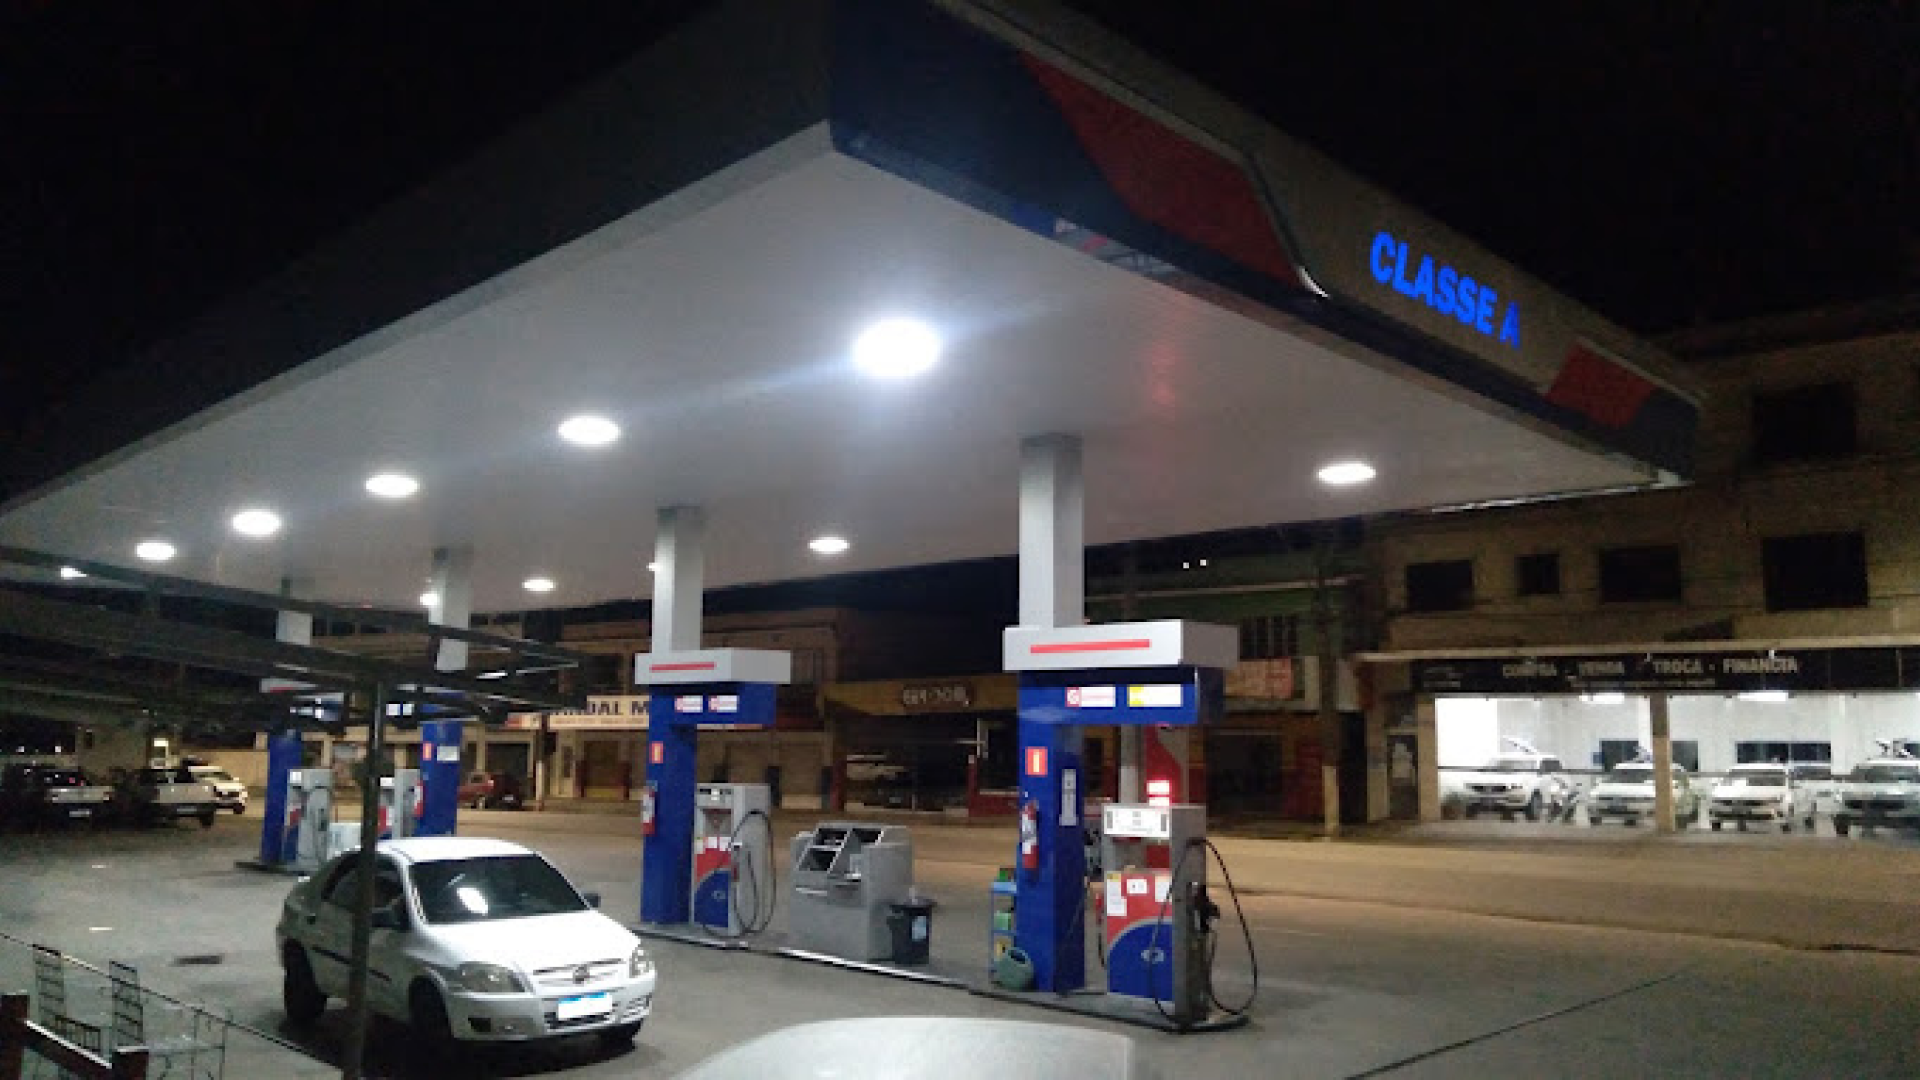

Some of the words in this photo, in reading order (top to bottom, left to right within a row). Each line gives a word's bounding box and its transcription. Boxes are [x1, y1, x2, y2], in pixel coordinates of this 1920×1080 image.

[1370, 231, 1498, 336] CLASSE
[1499, 302, 1521, 350] A
[1652, 658, 1703, 674] TROCA
[1722, 657, 1798, 673] FINANCIA
